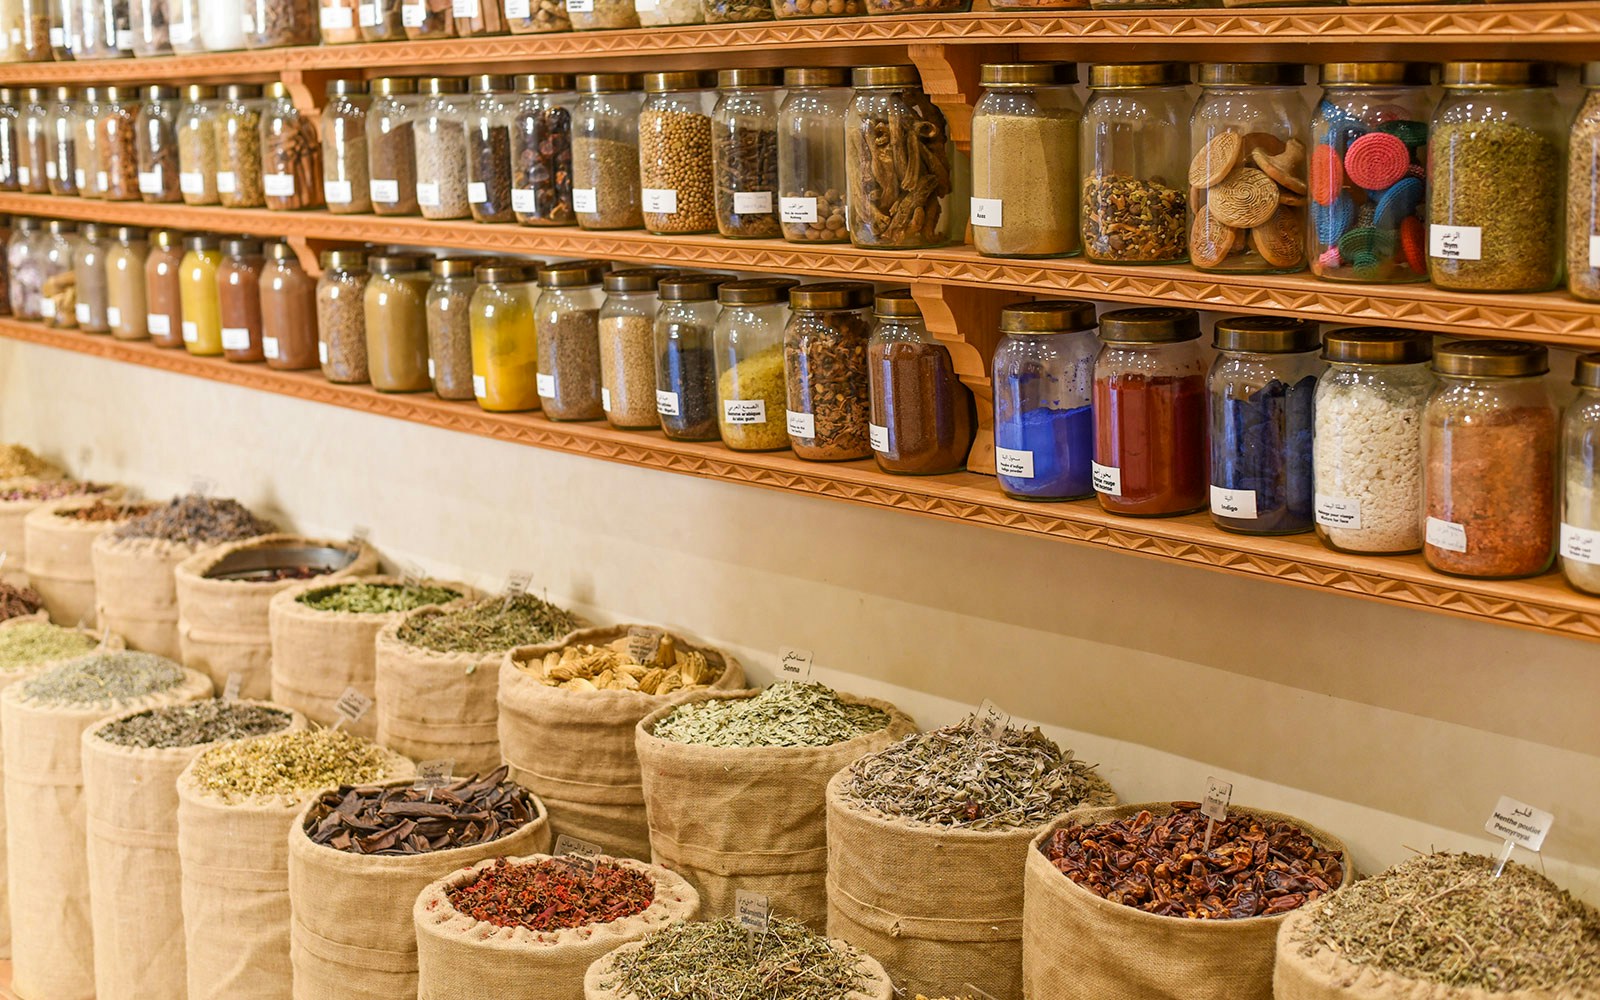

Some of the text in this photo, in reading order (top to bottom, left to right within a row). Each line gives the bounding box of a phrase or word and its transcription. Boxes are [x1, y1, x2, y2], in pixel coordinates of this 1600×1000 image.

[1221, 503, 1238, 512] Indigo
[783, 664, 800, 673] Senna
[1493, 811, 1518, 826] Menthe
[1494, 822, 1531, 842] Pennyroyal
